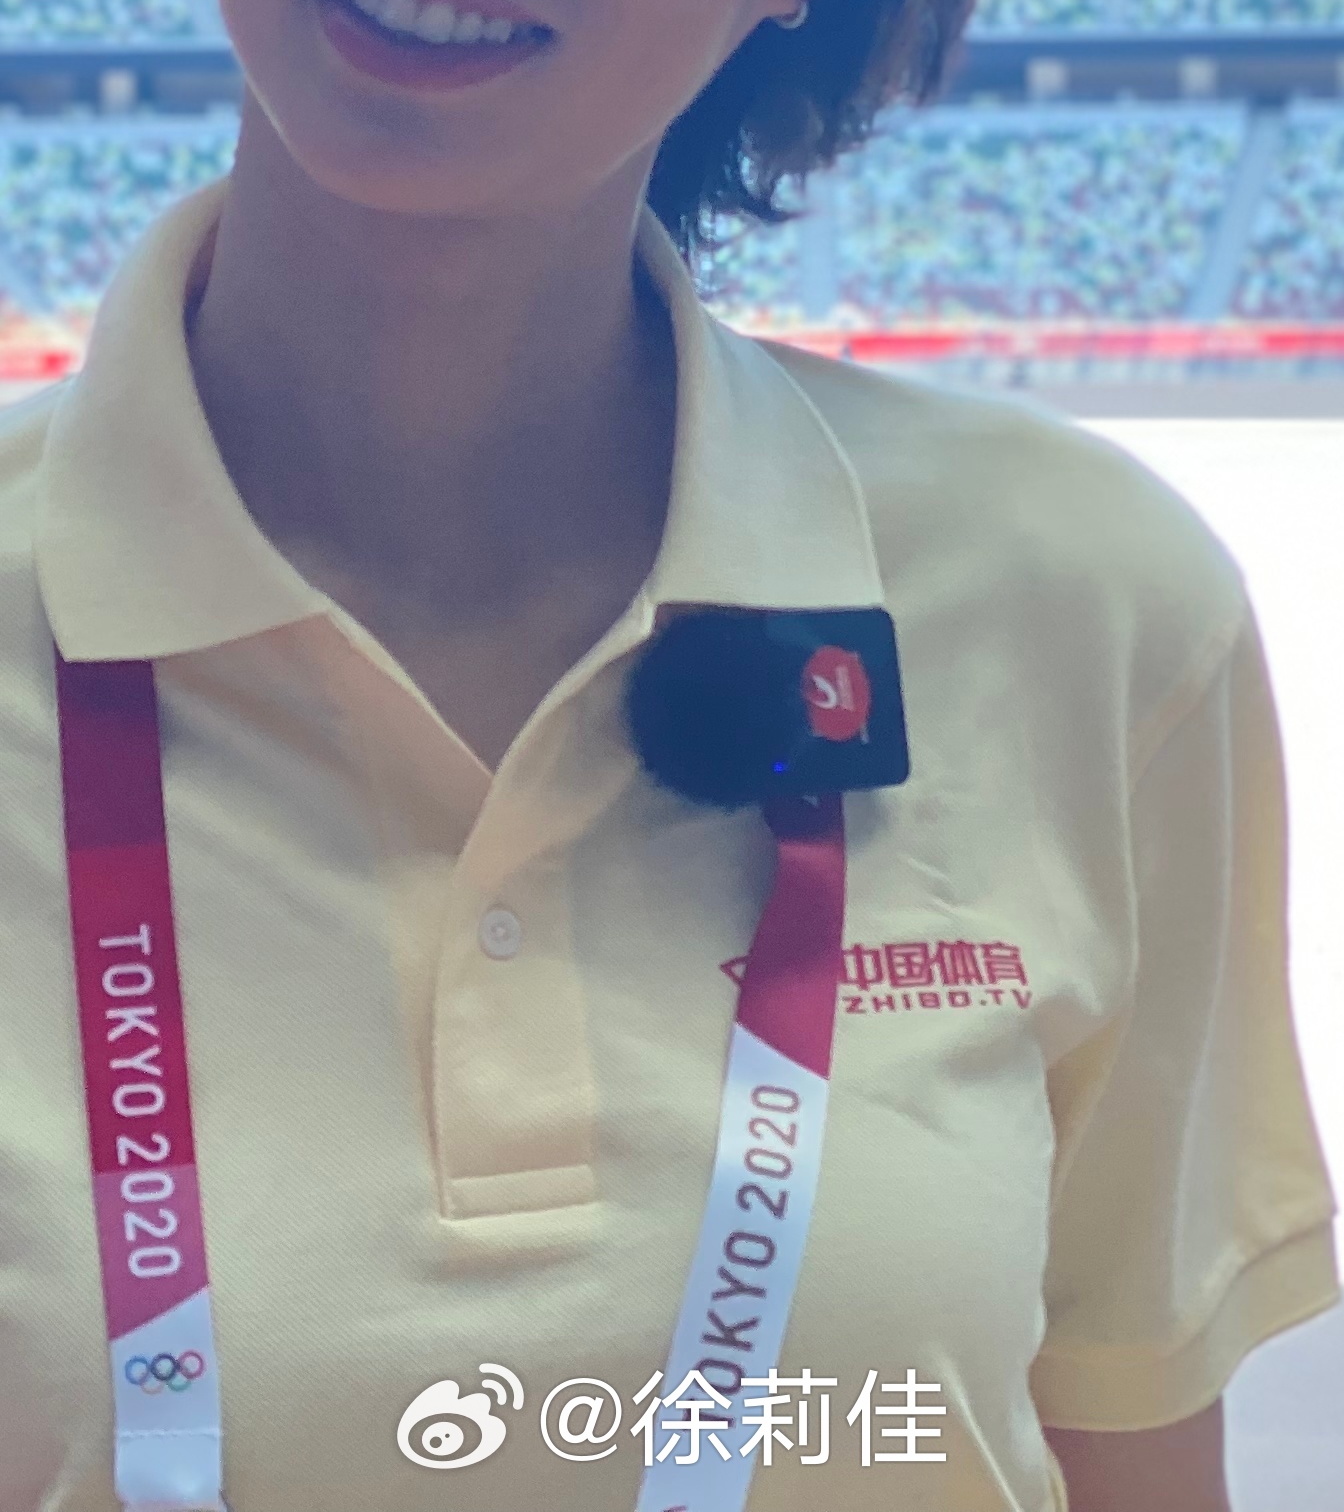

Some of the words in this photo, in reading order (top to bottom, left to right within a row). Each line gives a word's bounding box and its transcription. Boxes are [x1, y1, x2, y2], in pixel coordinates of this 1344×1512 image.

[99, 924, 167, 1118] TOKYO
[840, 941, 1028, 990] 中国体育
[843, 989, 1032, 1014] ZHIBO.TV
[116, 1134, 183, 1279] 2020
[736, 1084, 800, 1219] 2020
